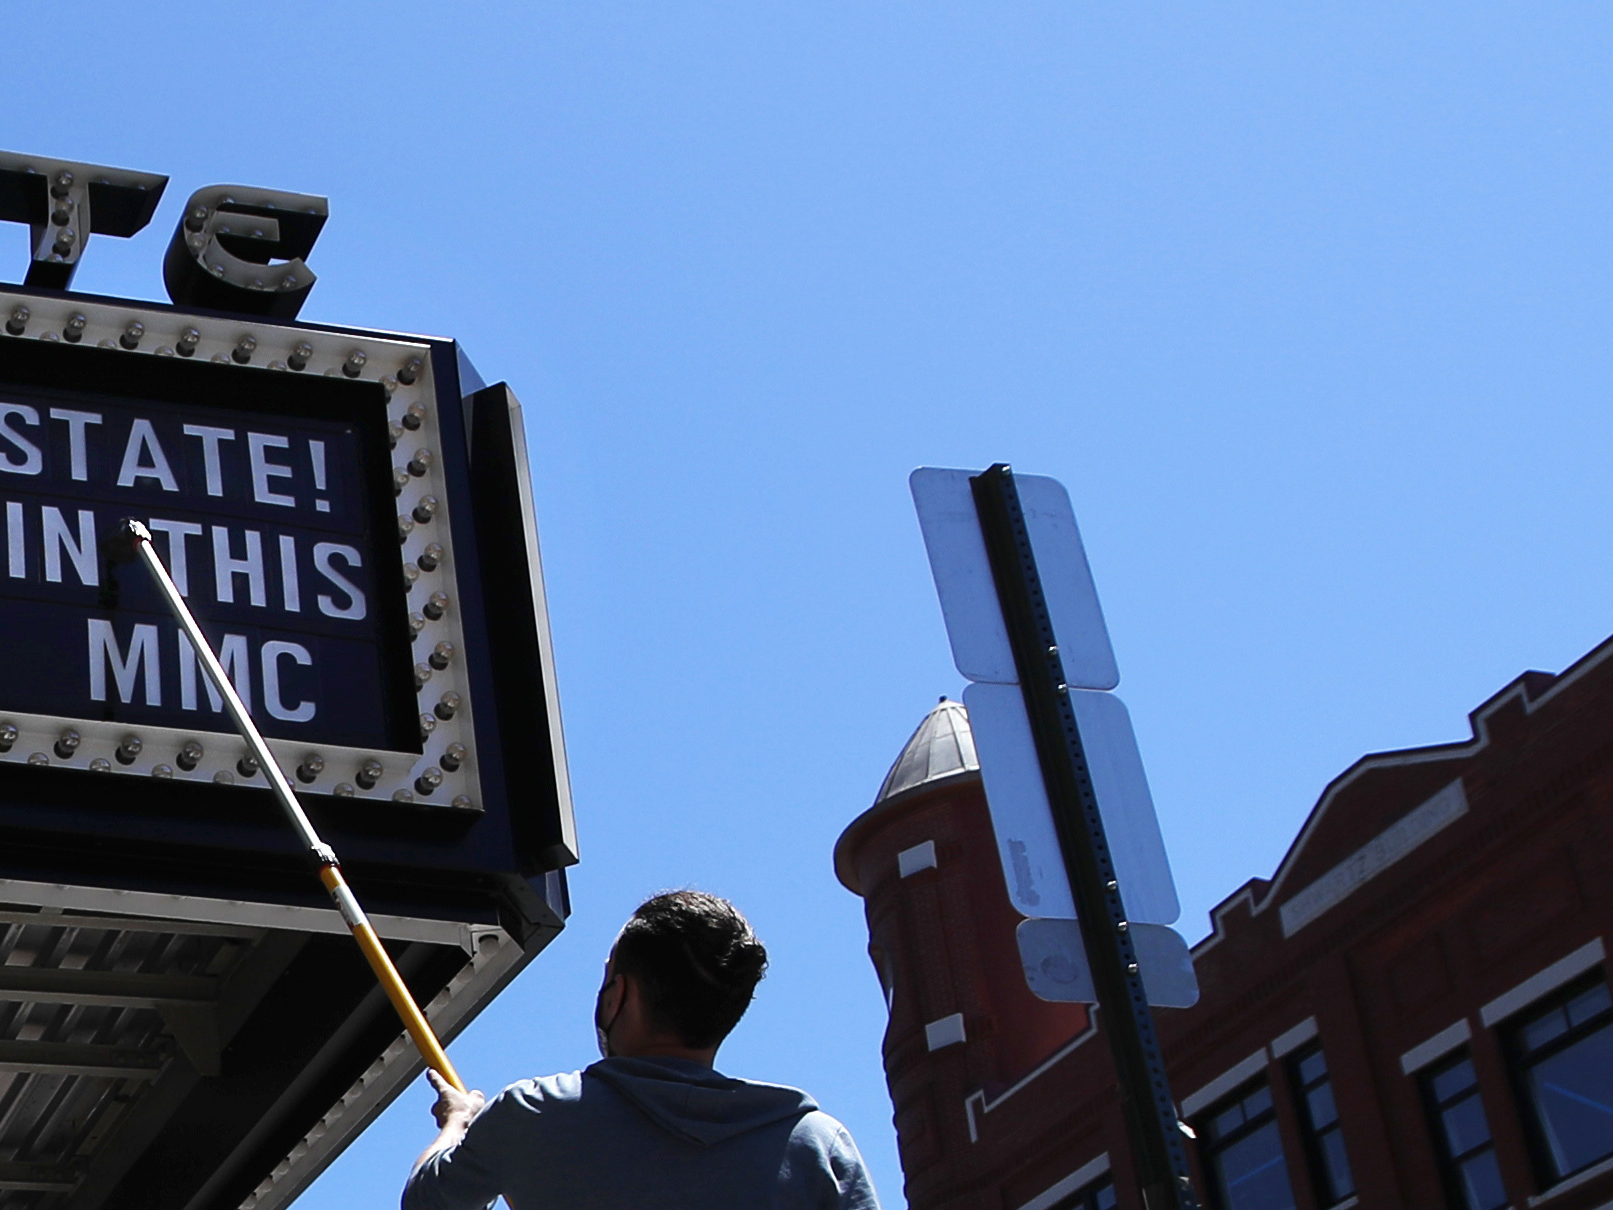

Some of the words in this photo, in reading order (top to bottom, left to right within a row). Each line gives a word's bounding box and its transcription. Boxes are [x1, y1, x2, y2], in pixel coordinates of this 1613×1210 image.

[5, 500, 100, 587] IN
[149, 517, 368, 622] THIS
[87, 618, 318, 724] MMC
